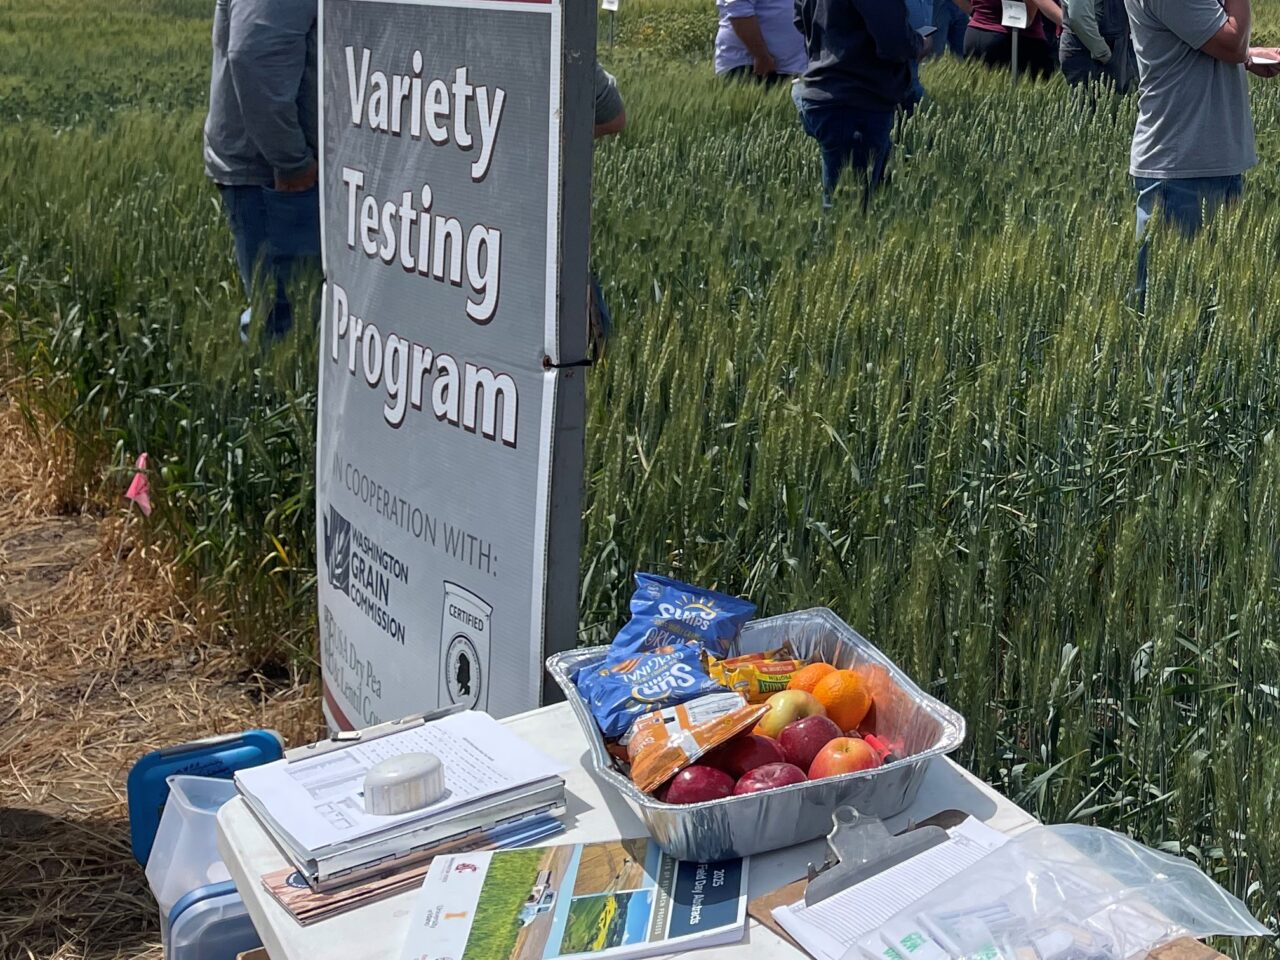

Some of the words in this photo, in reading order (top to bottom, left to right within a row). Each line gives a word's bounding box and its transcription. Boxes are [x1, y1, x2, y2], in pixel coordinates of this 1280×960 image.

[344, 45, 506, 182] Variety
[342, 167, 502, 325] Testing
[332, 283, 518, 448] Program
[345, 463, 437, 546] COOPERATION
[443, 522, 498, 577] WITH:
[351, 526, 409, 584] WASHINGTON
[351, 552, 390, 606] GRAIN
[350, 583, 406, 645] COMMISSION
[449, 604, 484, 632] CERTIFIED
[349, 642, 365, 683] Dry
[366, 660, 382, 699] Pea
[692, 880, 706, 893] Day
[697, 864, 708, 880] Field
[712, 869, 725, 887] 2025
[689, 894, 704, 925] Abstracts
